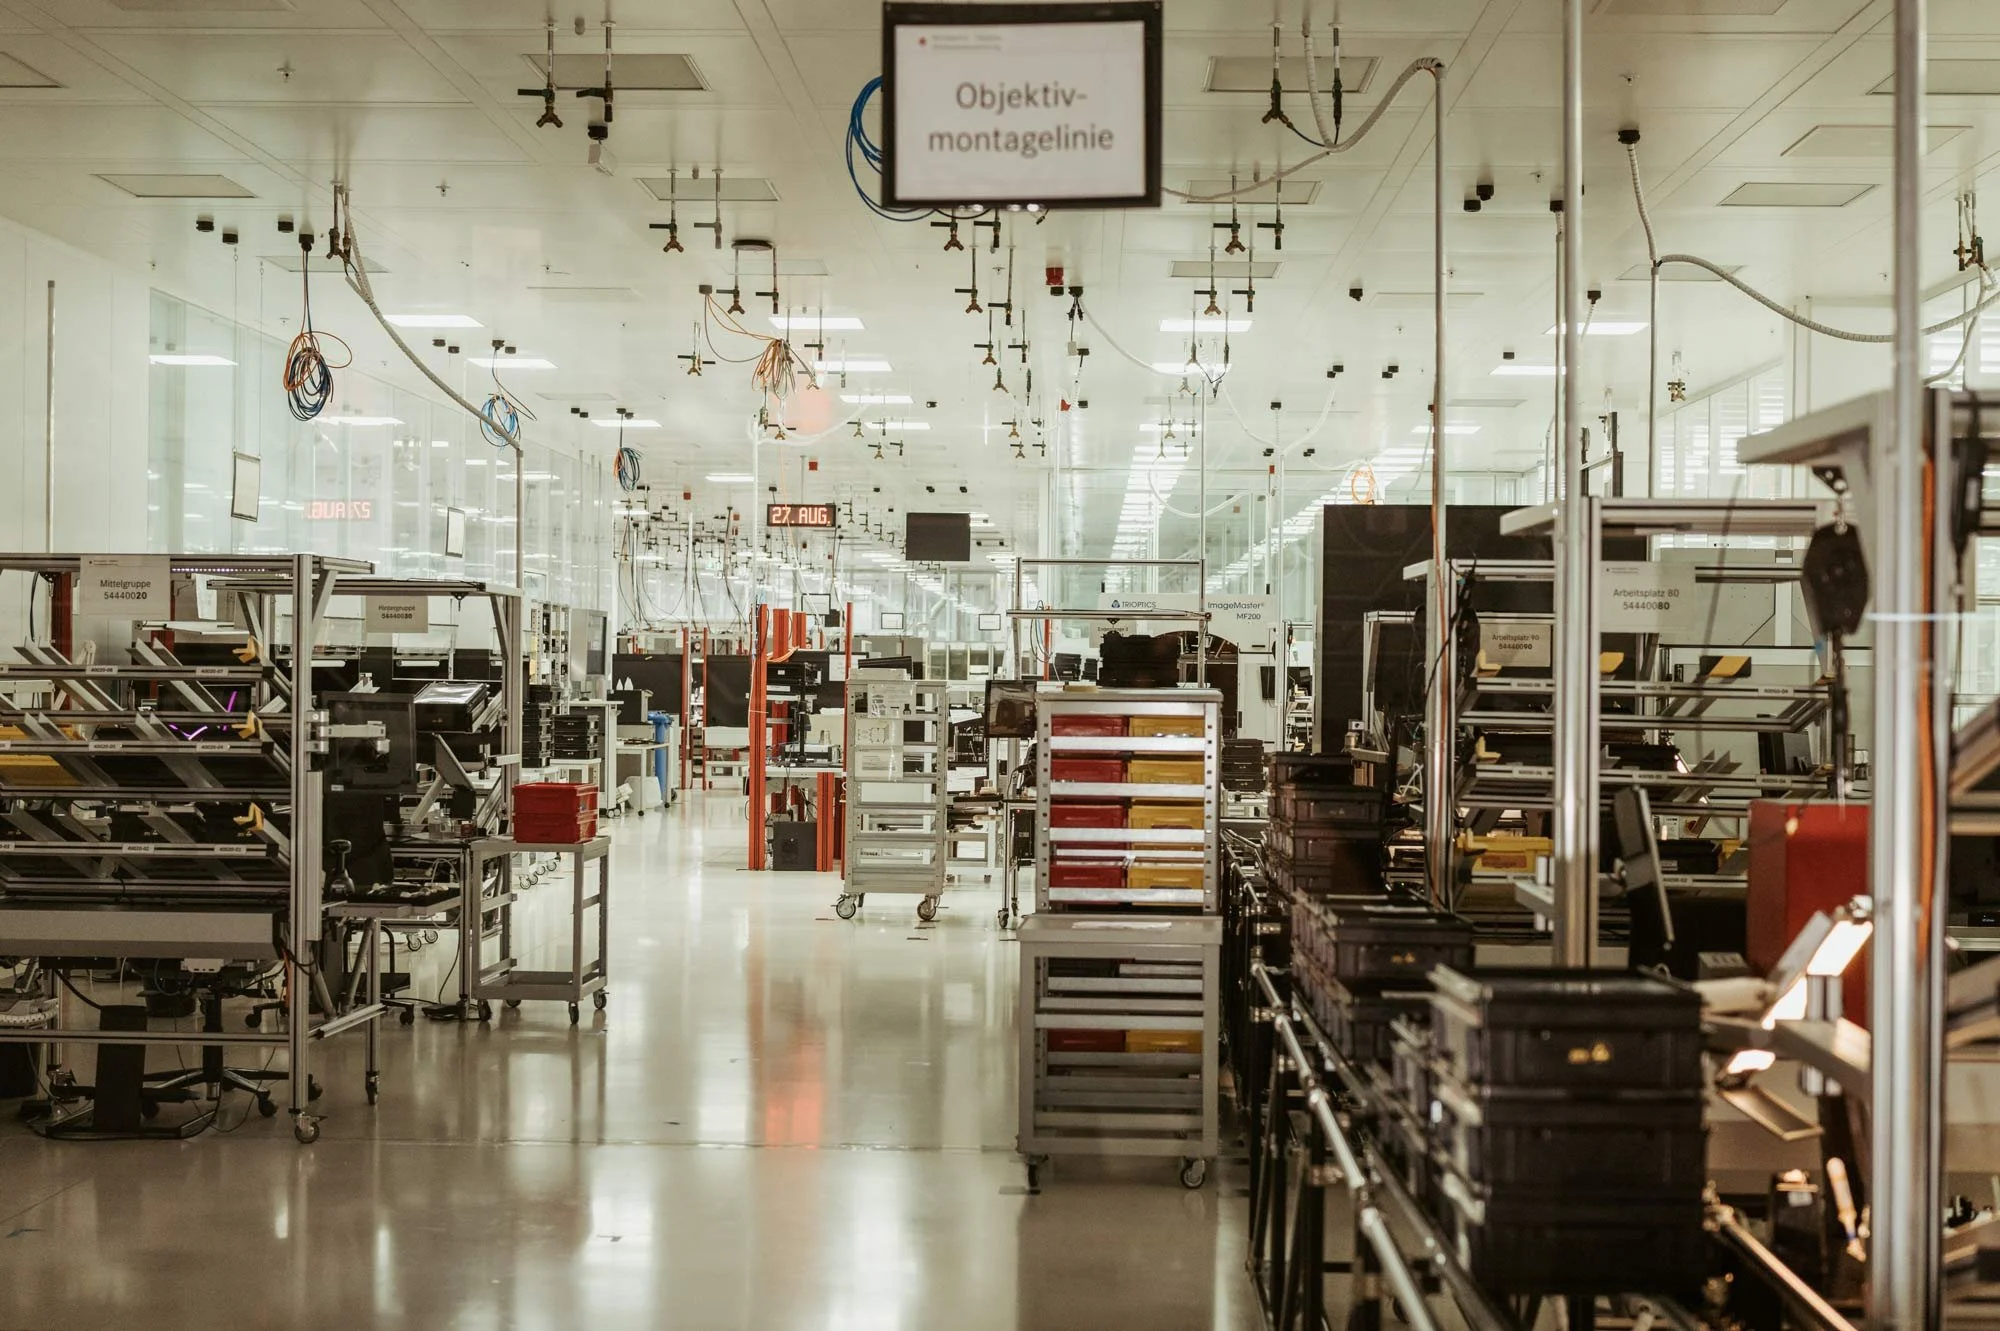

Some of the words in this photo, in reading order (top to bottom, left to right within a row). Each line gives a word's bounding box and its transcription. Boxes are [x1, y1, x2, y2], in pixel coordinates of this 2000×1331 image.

[956, 81, 1088, 116] Objektiv-
[928, 123, 1114, 159] montagelinie
[772, 506, 795, 524] 27.
[798, 507, 831, 524] AUG.
[100, 580, 151, 589] Mittelgruppe
[104, 591, 147, 600] 54440020
[1613, 588, 1666, 598] Arbeitsplatz
[1667, 588, 1680, 598] 80
[1623, 601, 1670, 610] 54440080
